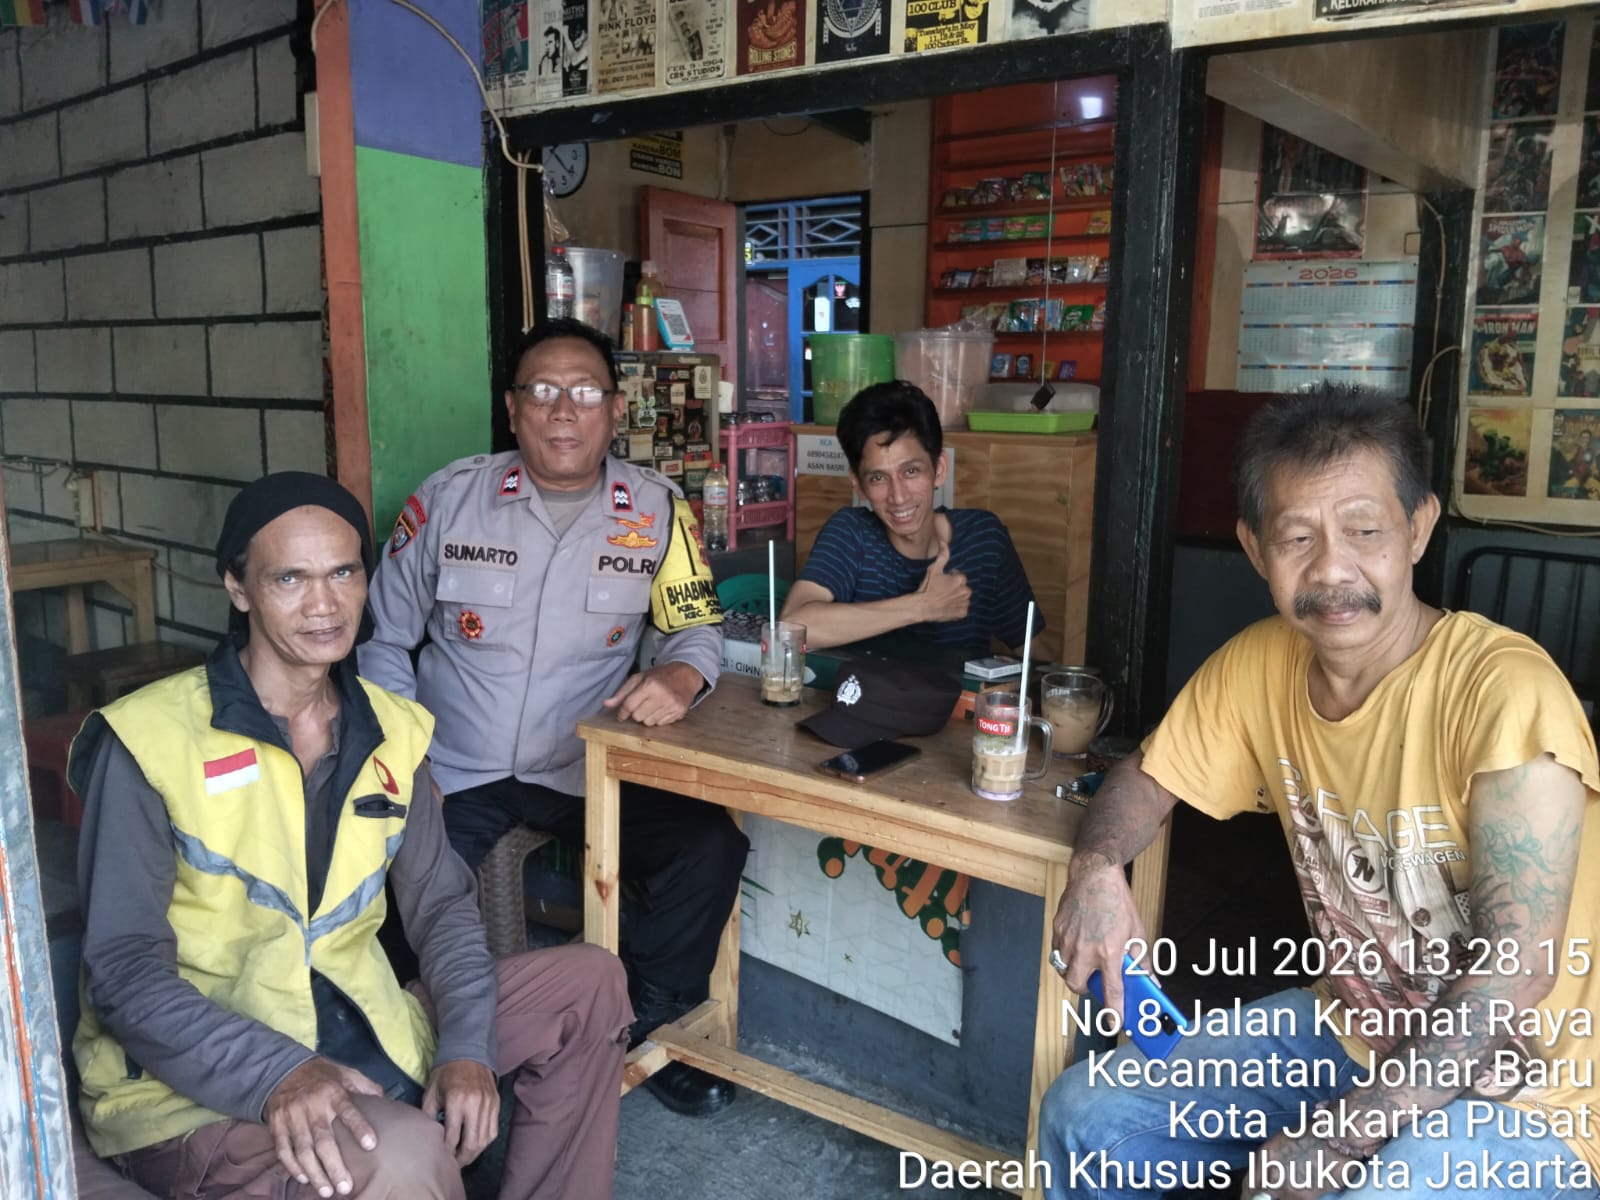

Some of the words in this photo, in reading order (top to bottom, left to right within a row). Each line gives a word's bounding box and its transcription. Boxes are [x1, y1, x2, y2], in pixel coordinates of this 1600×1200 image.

[909, 3, 927, 14] 100
[928, 0, 956, 12] CLUB
[598, 21, 621, 33] PINK
[624, 14, 656, 28] FLOYD
[960, 22, 976, 31] May
[687, 65, 720, 76] STUDIOS
[1299, 267, 1359, 280] 2026
[1484, 320, 1509, 334] IRON
[1511, 319, 1536, 334] MAN
[444, 543, 518, 566] SUNARTO
[598, 555, 657, 575] POLRI
[677, 603, 700, 613] KEL.
[684, 609, 706, 620] KEC.
[979, 719, 999, 732] TONG
[999, 723, 1010, 734] TJI
